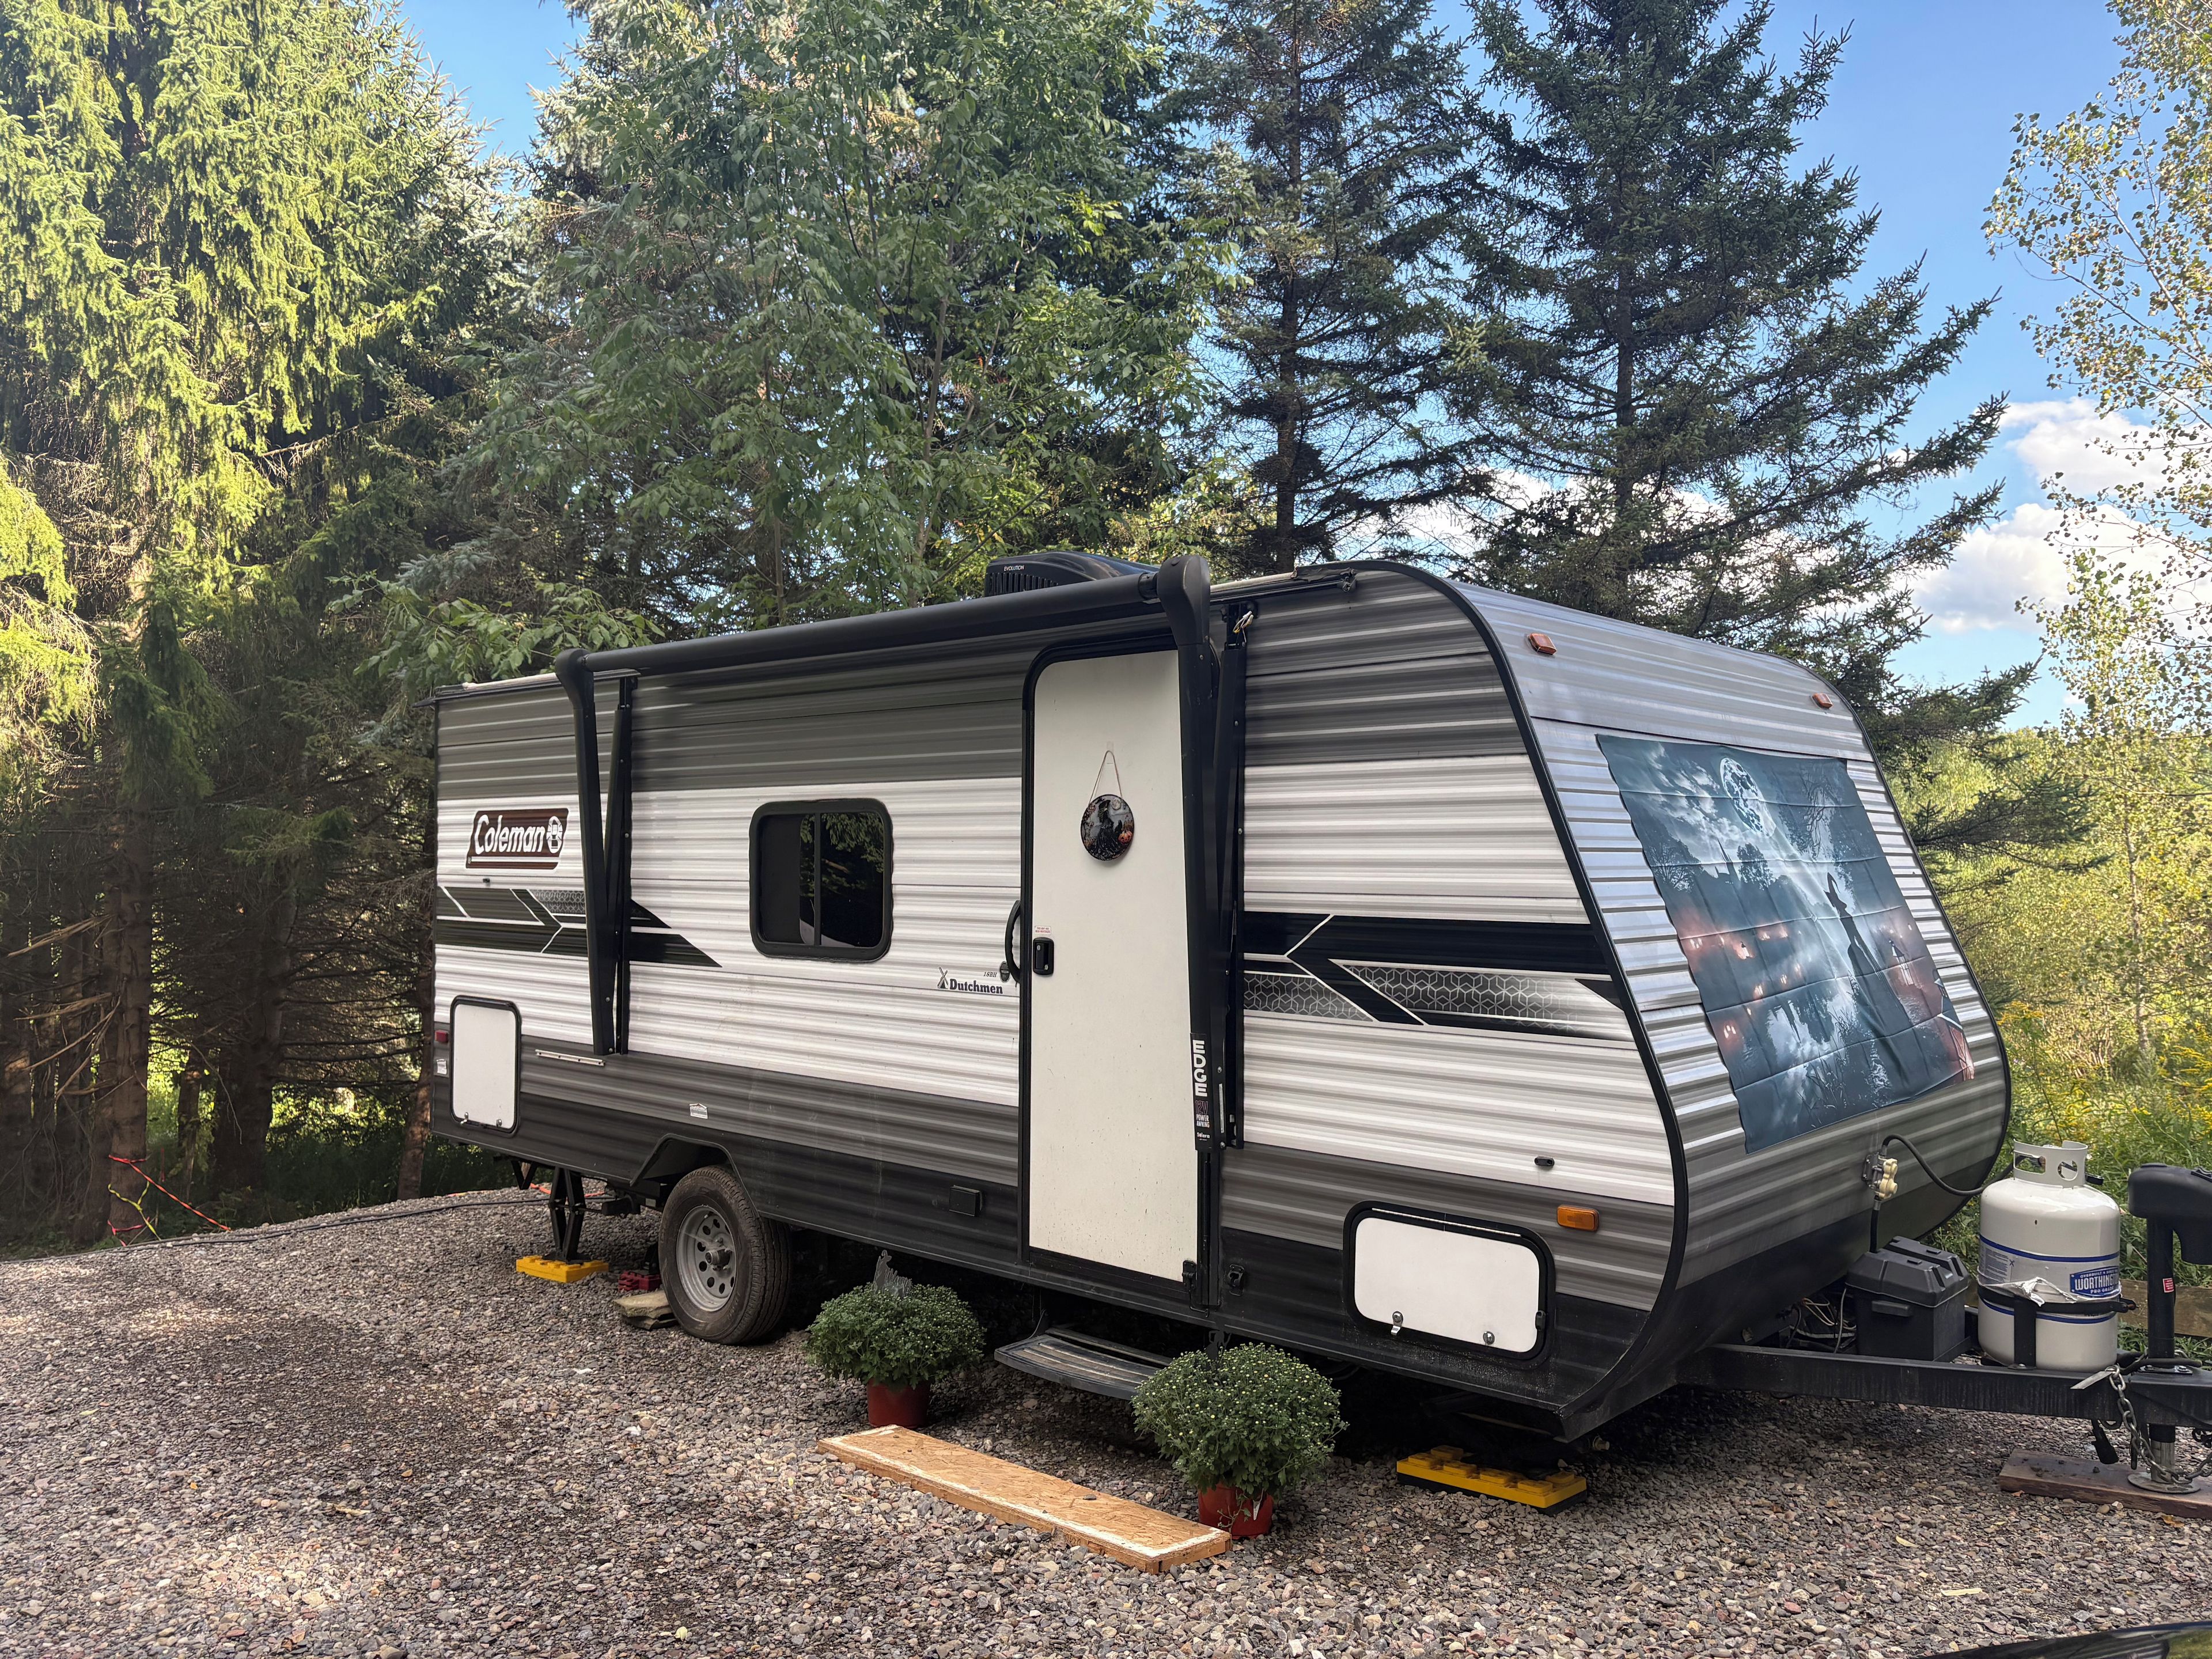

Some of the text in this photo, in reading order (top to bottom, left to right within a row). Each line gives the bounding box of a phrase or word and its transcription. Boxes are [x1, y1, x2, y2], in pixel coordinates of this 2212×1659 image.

[474, 814, 546, 855] Coleman
[949, 979, 1003, 994] Dutchmen
[1192, 1039, 1208, 1097] EDGE
[1195, 1100, 1209, 1115] 12V
[1196, 1113, 1209, 1122] POWER
[2074, 1273, 2119, 1290] WORTHINGTO
